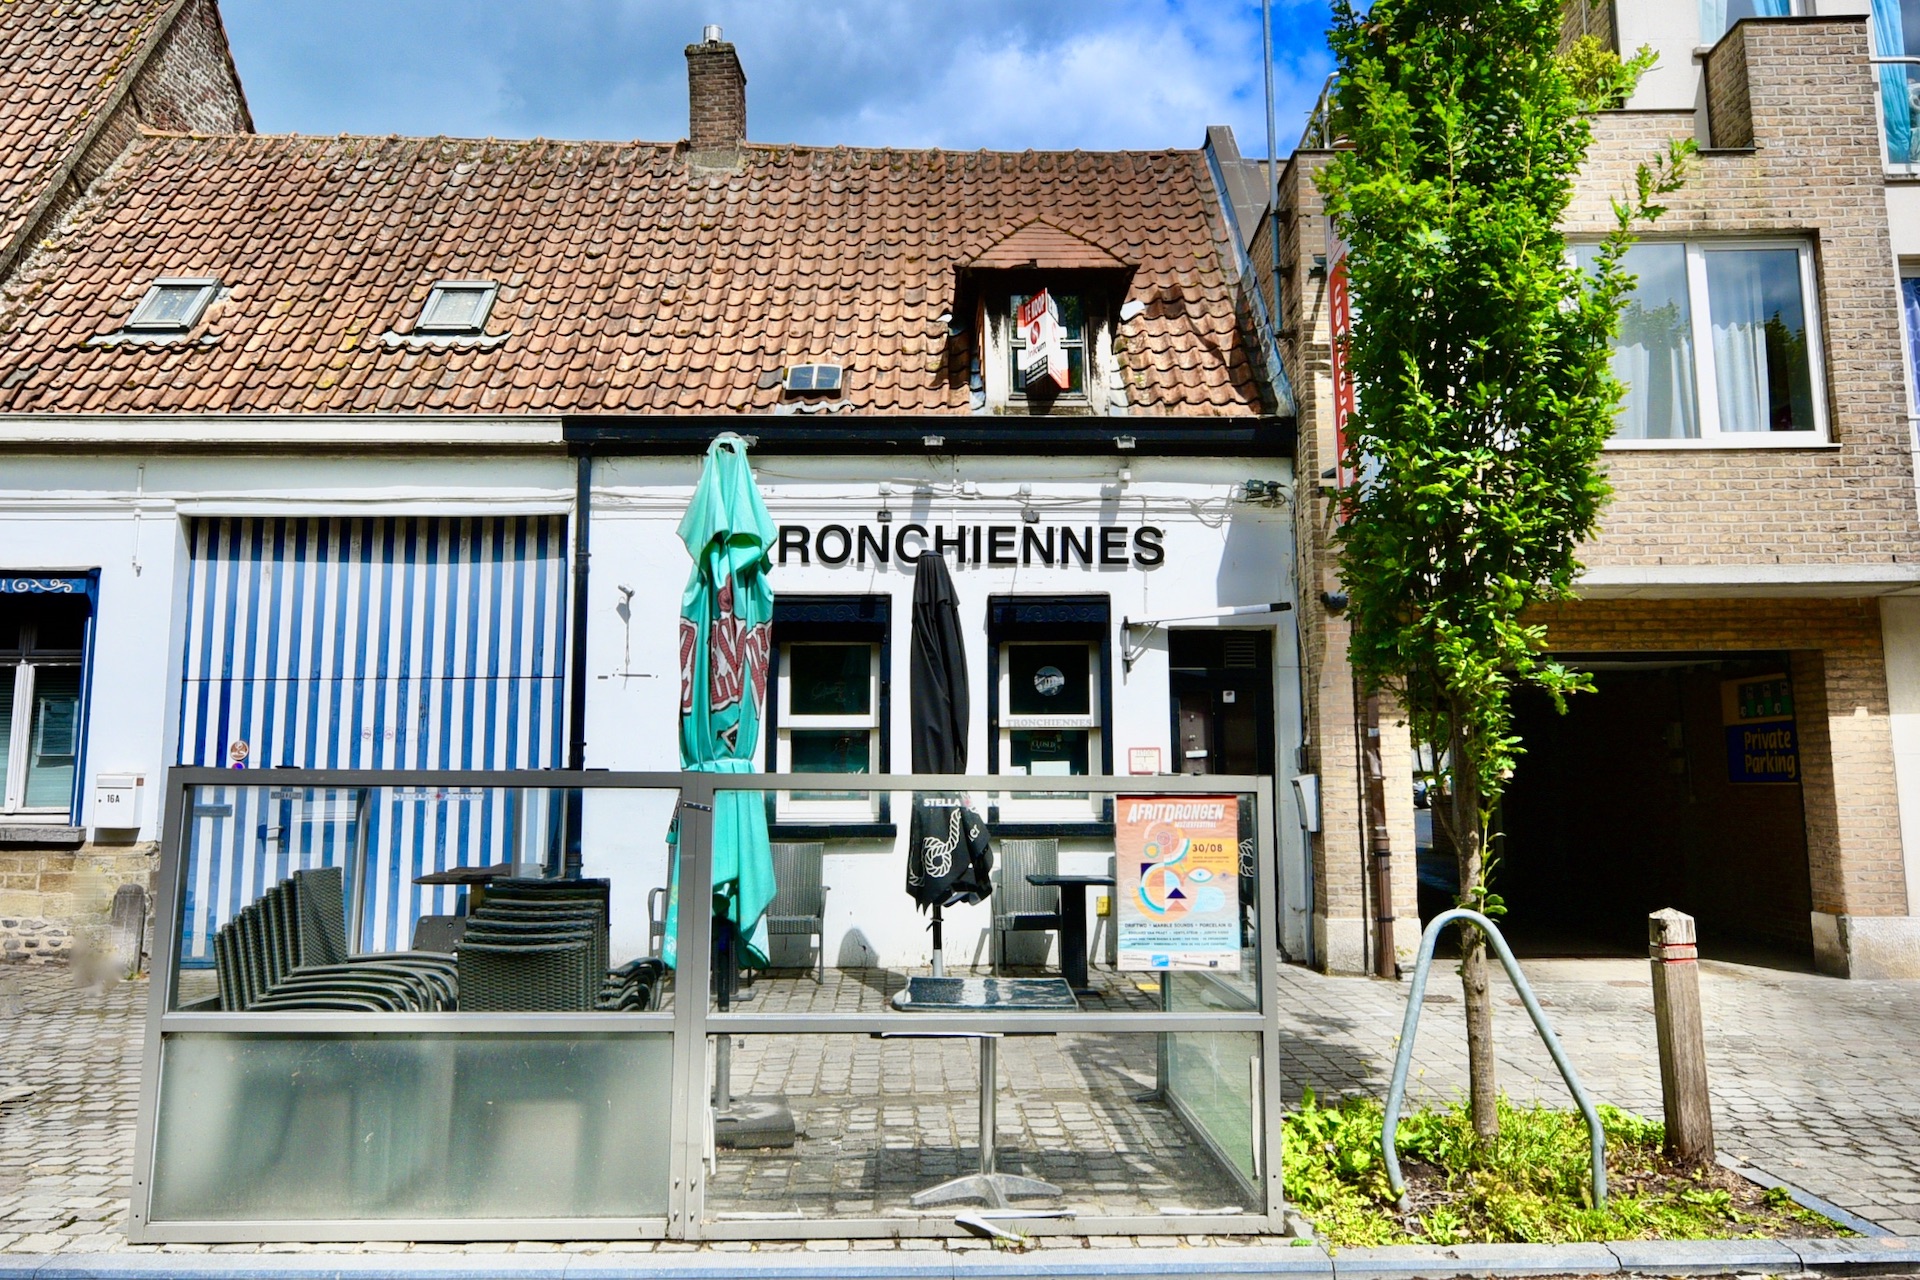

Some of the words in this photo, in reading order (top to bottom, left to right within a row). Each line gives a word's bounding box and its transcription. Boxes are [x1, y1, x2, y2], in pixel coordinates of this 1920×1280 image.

[778, 524, 1165, 565] RONCHIENNES
[1006, 718, 1093, 728] TRONCHIENNES
[1743, 728, 1792, 751] Private
[1744, 750, 1796, 780] Parking
[107, 794, 120, 804] 16A
[923, 798, 961, 807] STELLA
[1192, 843, 1223, 854] 30/08
